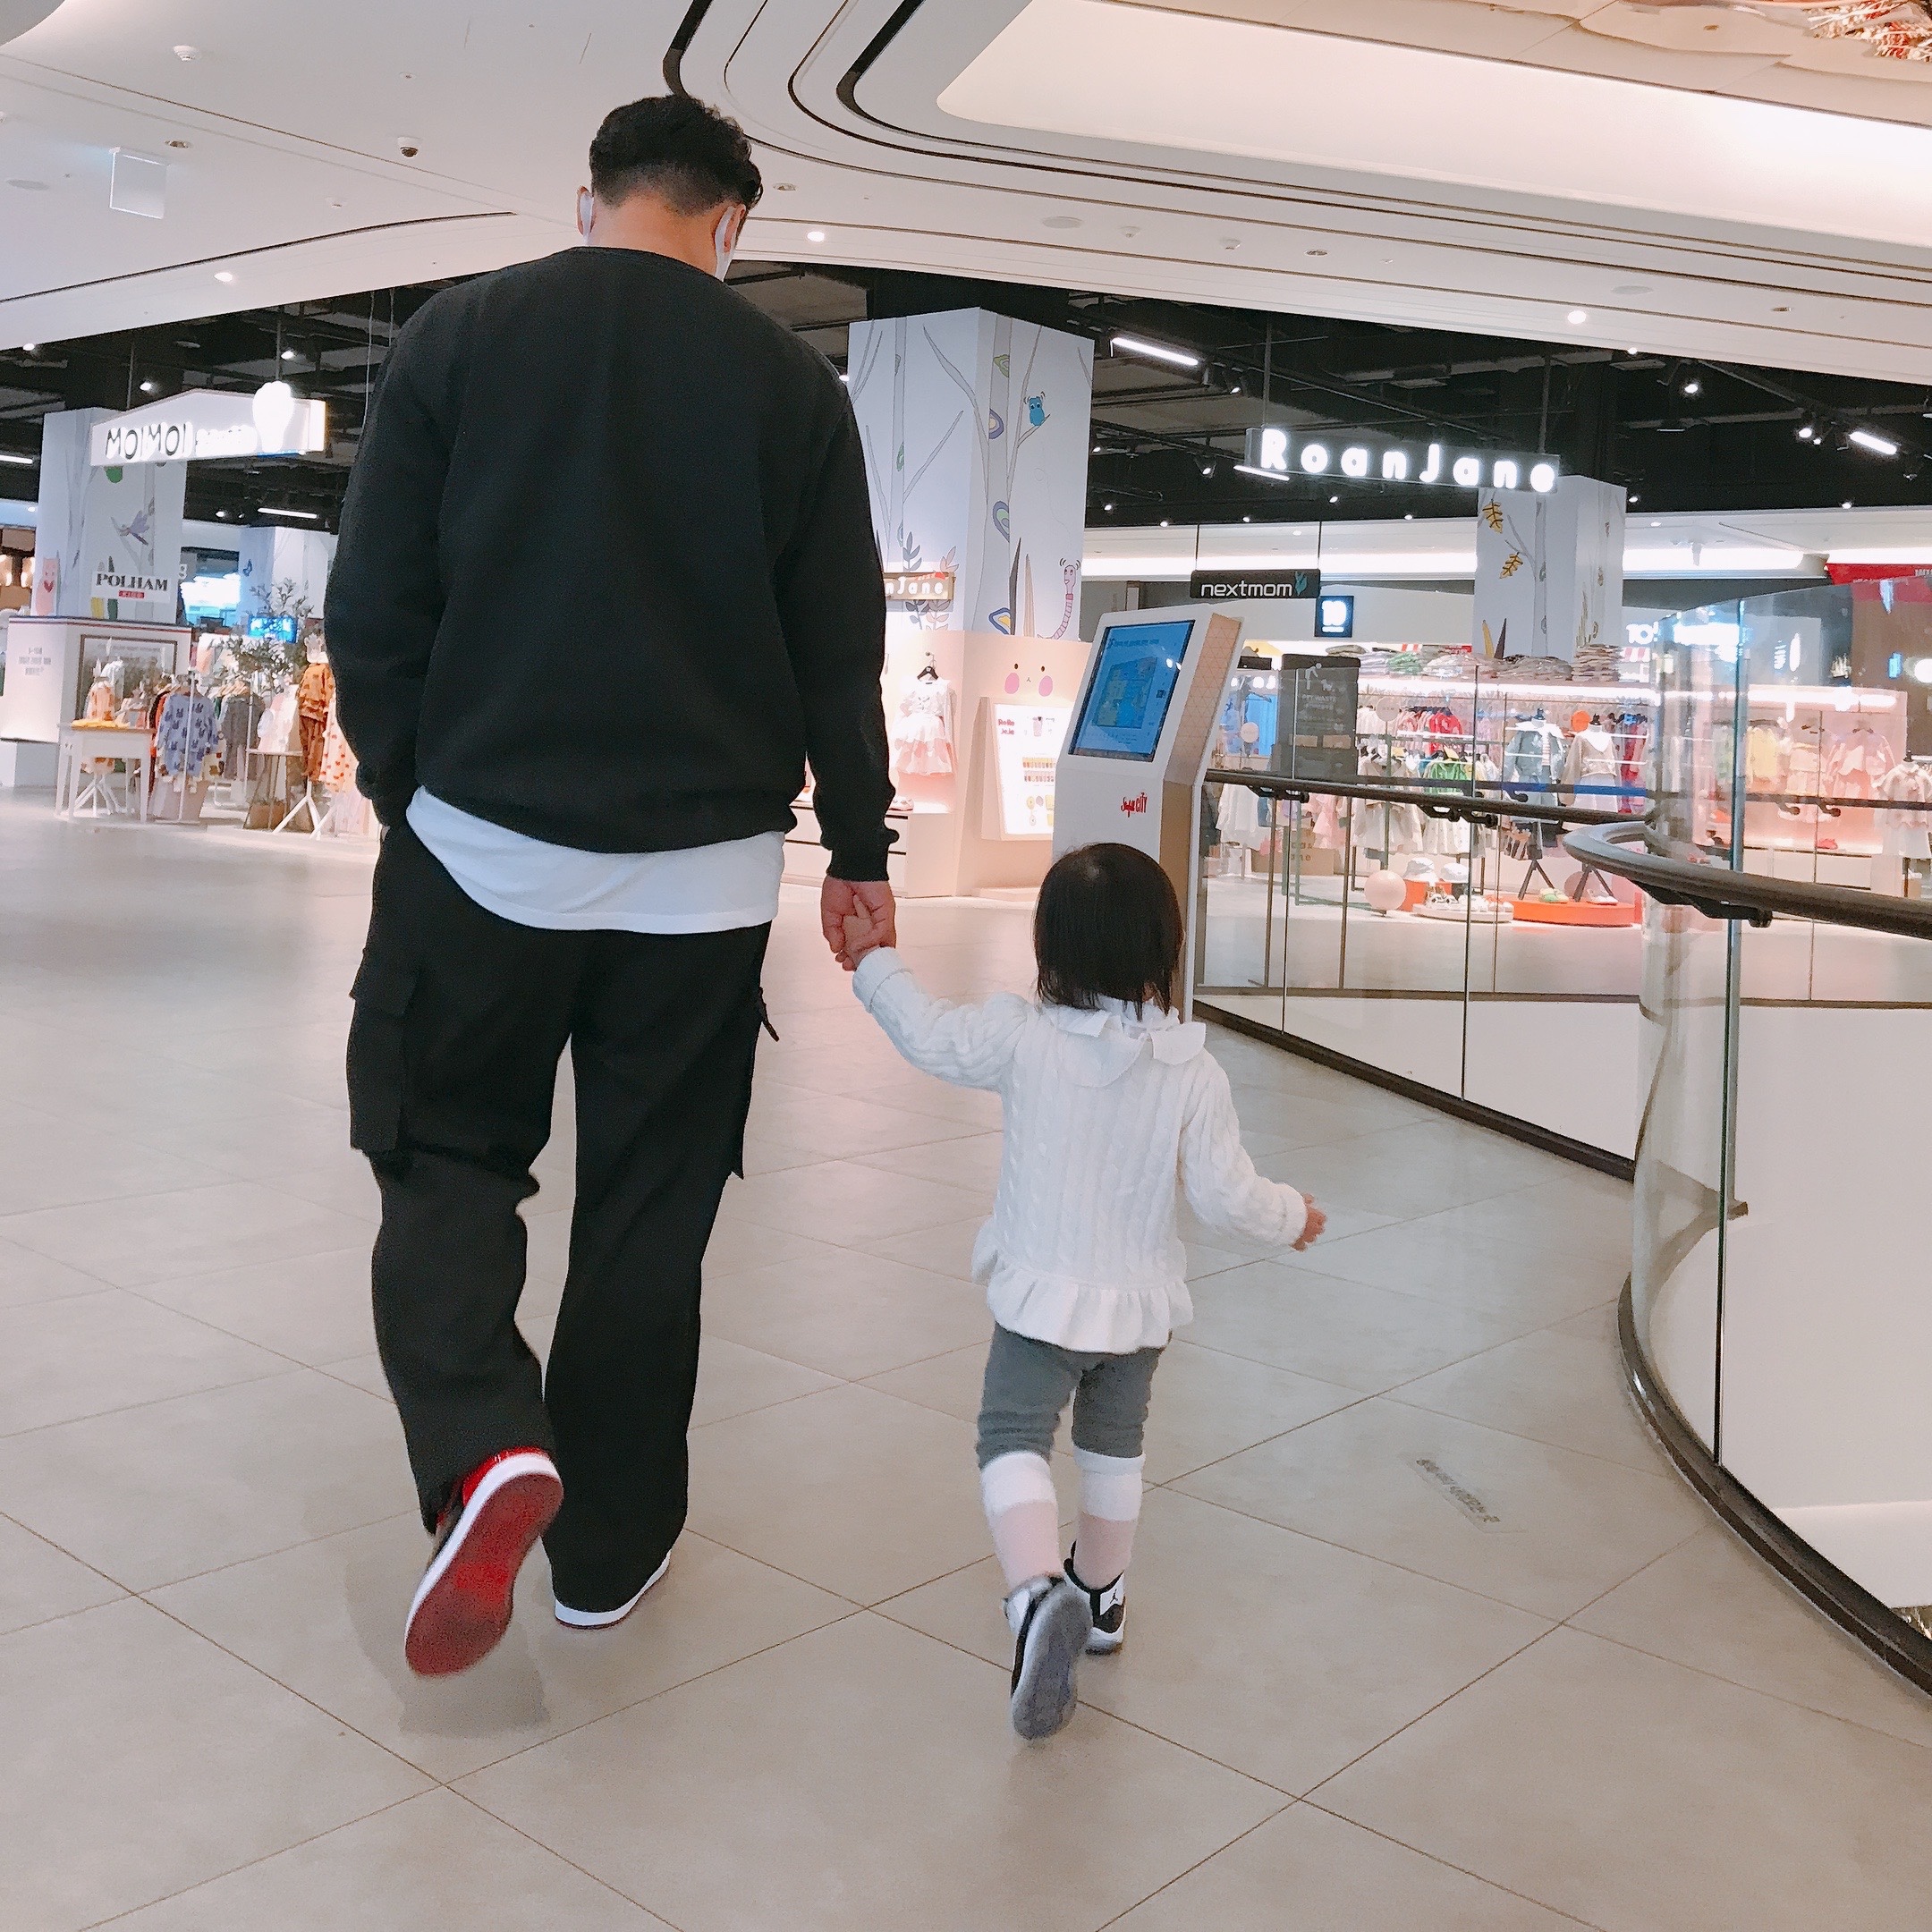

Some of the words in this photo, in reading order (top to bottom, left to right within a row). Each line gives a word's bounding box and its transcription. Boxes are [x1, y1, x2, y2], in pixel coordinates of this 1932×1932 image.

[105, 422, 187, 460] MOIMOI
[1261, 428, 1555, 493] RoanJane
[96, 572, 168, 591] POLHAM
[885, 575, 944, 595] nJane
[1200, 580, 1292, 597] nextmom
